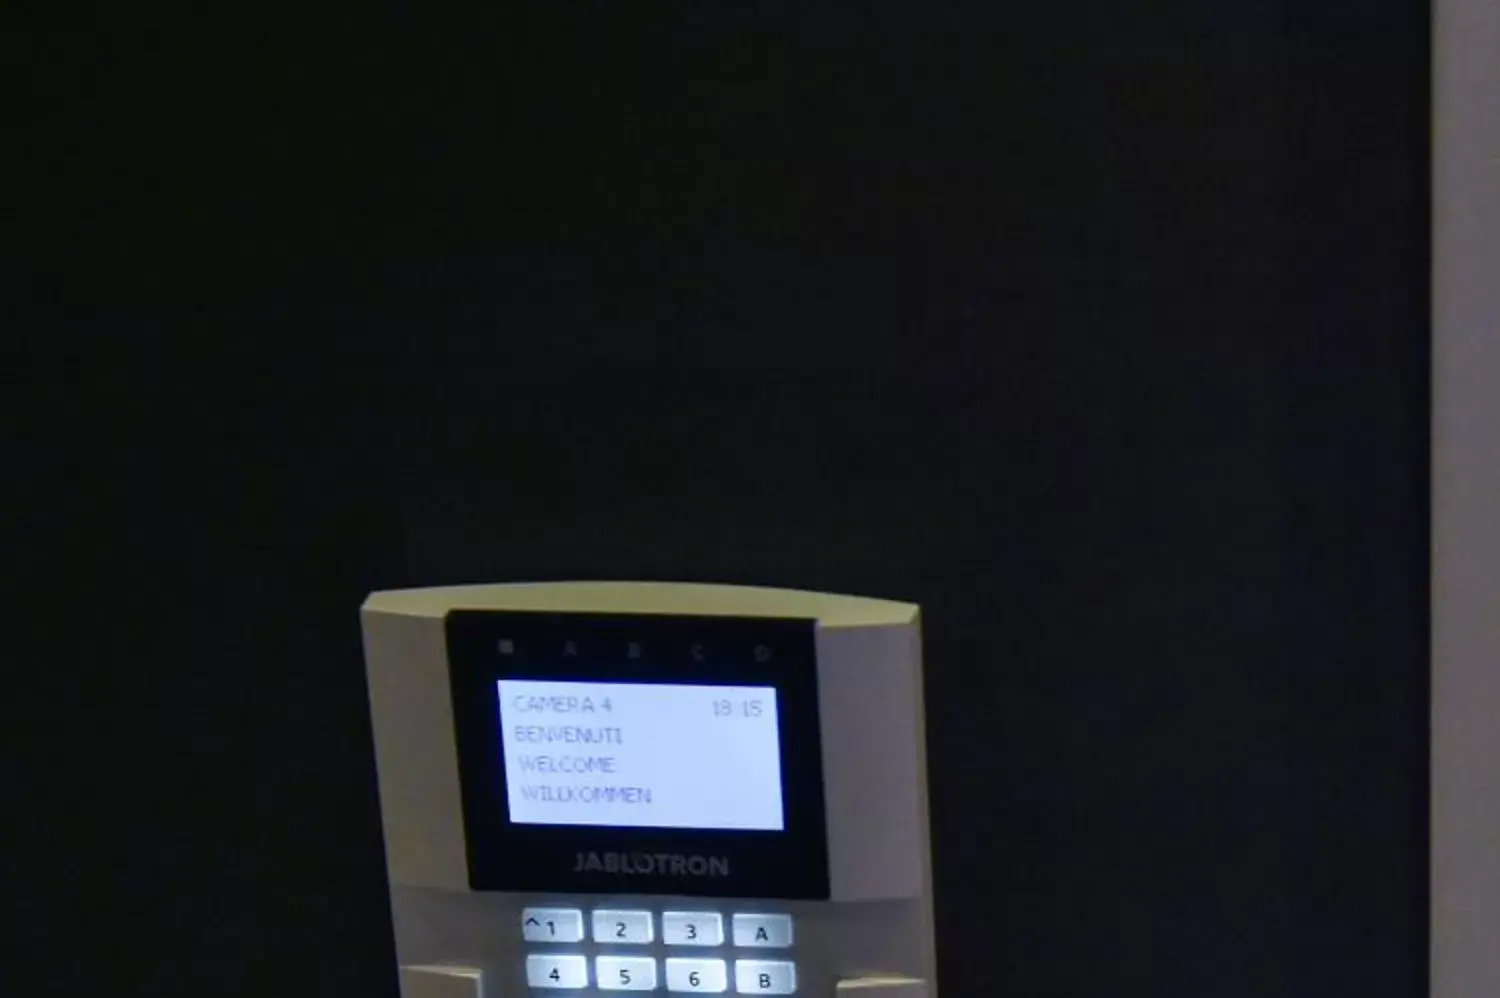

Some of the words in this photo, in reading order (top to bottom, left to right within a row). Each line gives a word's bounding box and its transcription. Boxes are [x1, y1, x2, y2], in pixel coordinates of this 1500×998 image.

[514, 695, 596, 713] CAMERA
[515, 725, 623, 745] BENVENUTI
[518, 755, 617, 774] WELCOME
[520, 784, 653, 804] WILLKOMMEN
[573, 852, 728, 877] JABLOTRON
[546, 920, 556, 937] 1
[616, 922, 627, 938] 2
[687, 924, 697, 940] 3
[755, 926, 769, 942] A
[549, 967, 560, 982] 4
[620, 969, 630, 985] 5
[689, 971, 700, 987] 6
[759, 973, 771, 989] B
